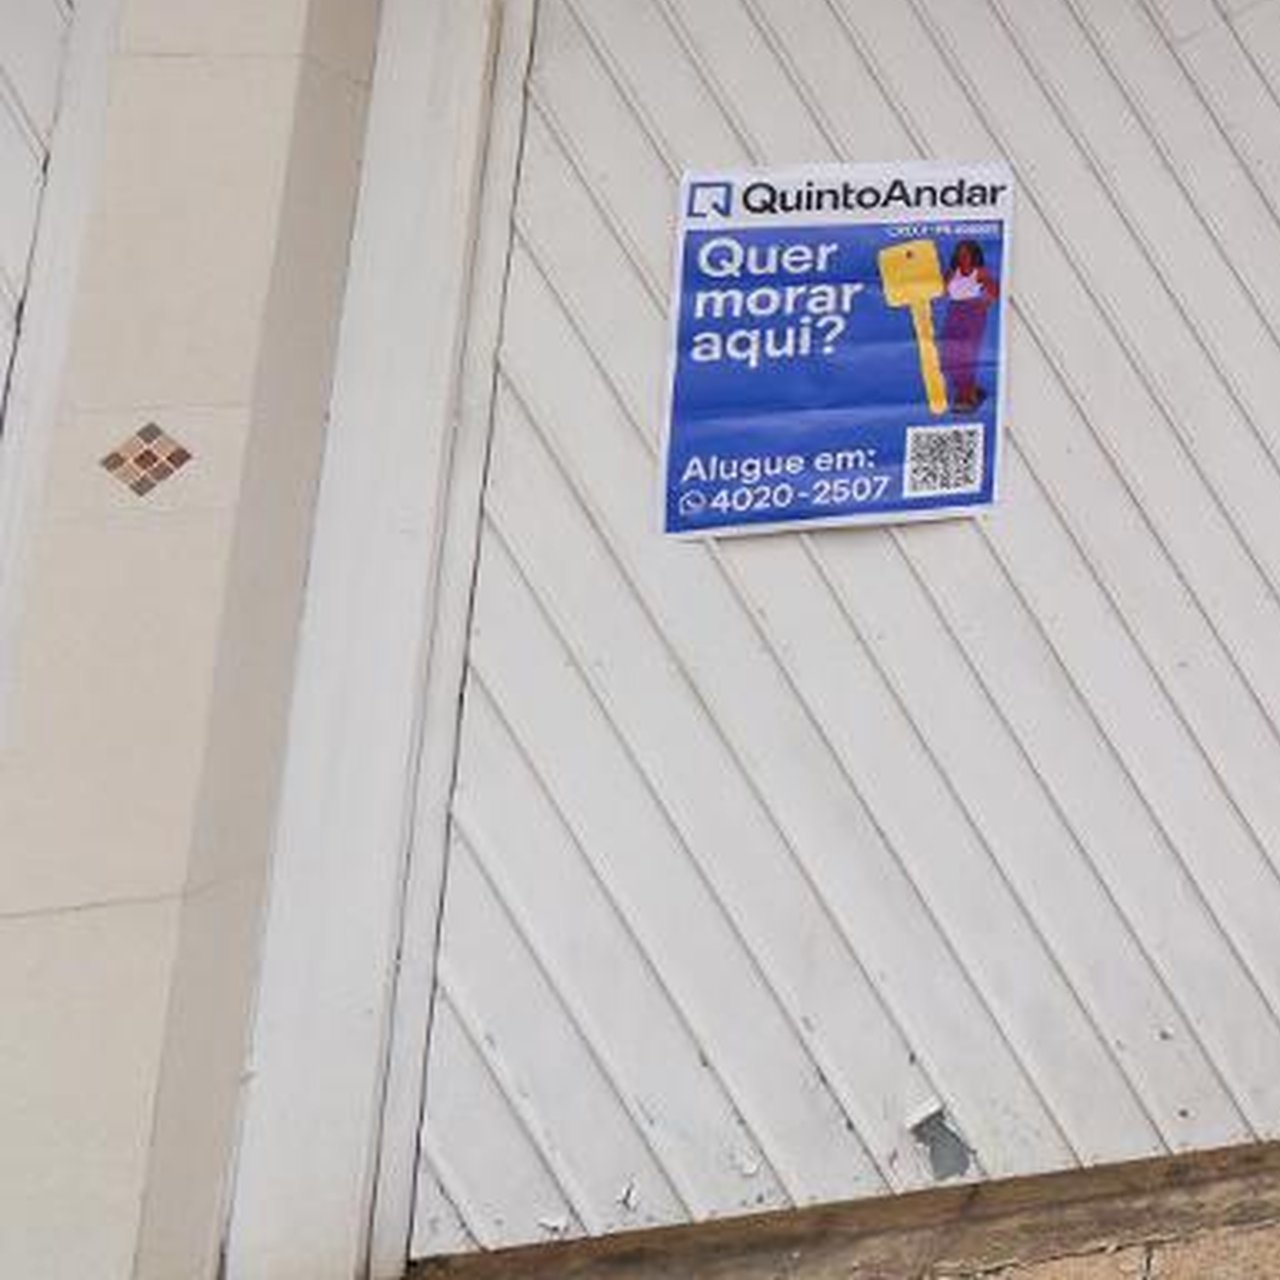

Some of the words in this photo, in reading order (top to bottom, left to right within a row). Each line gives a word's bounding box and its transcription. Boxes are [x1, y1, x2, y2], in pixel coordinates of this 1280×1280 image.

[742, 178, 1006, 214] QuintoAndar
[697, 236, 838, 278] Quer
[693, 282, 864, 319] morar
[690, 315, 846, 369] aqui?
[682, 454, 804, 484] Alugue
[814, 447, 876, 471] em:
